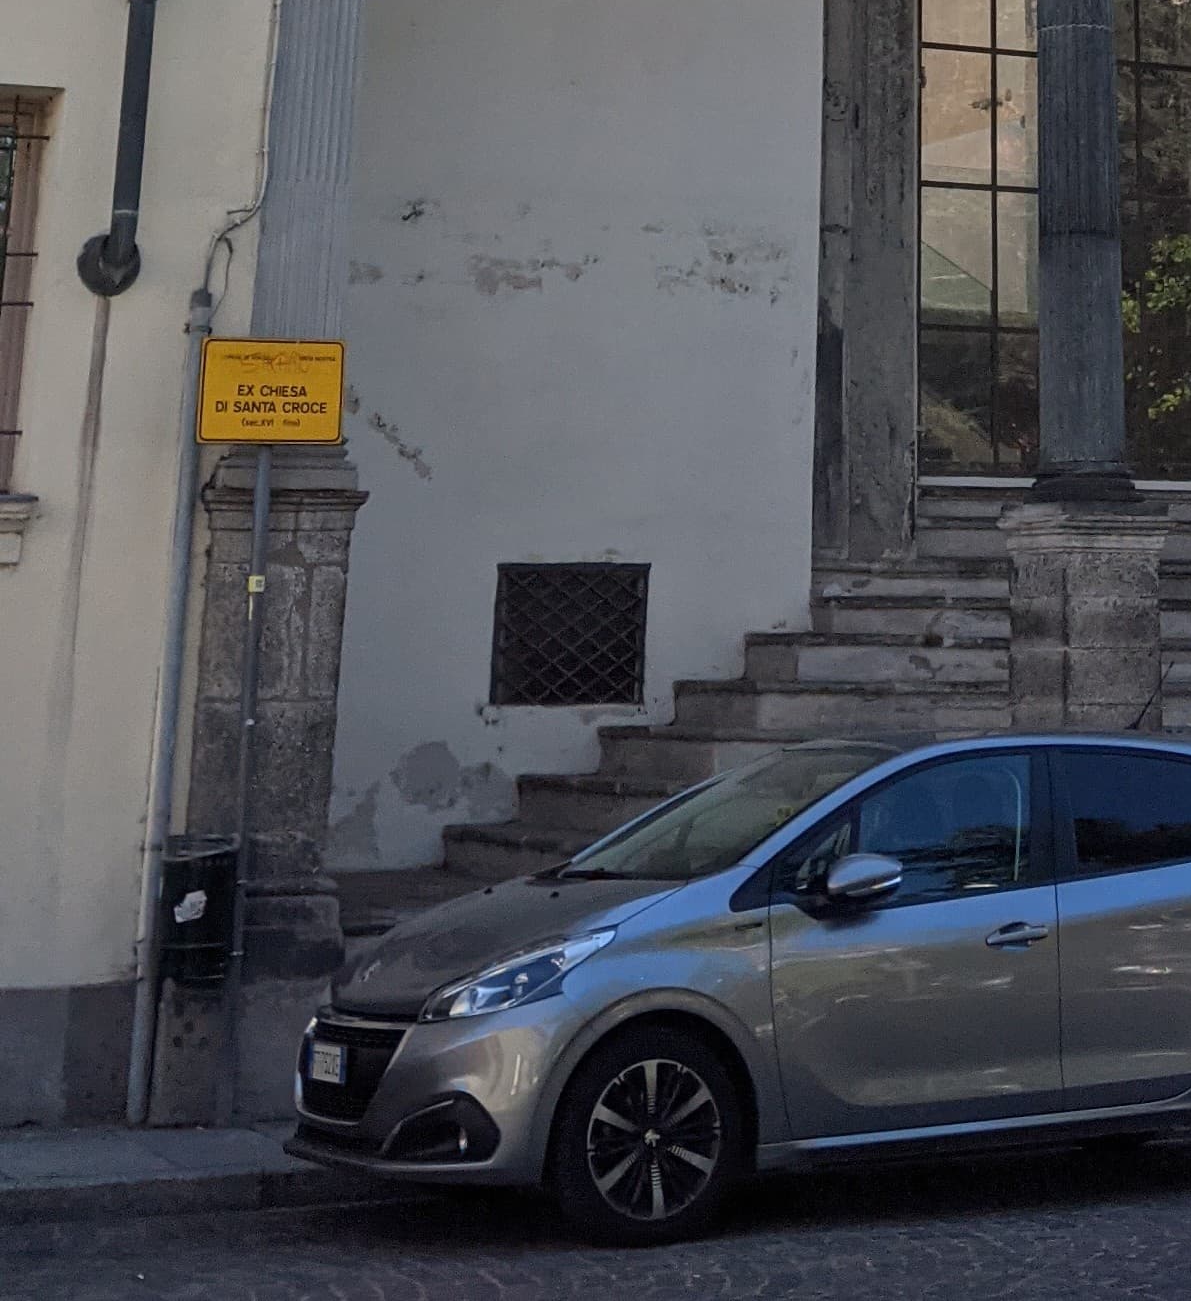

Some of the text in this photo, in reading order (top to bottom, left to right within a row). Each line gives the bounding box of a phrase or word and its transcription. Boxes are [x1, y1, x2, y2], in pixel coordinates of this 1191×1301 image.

[237, 384, 308, 397] EX CHIESA
[215, 401, 328, 414] DI SANTA CROCE
